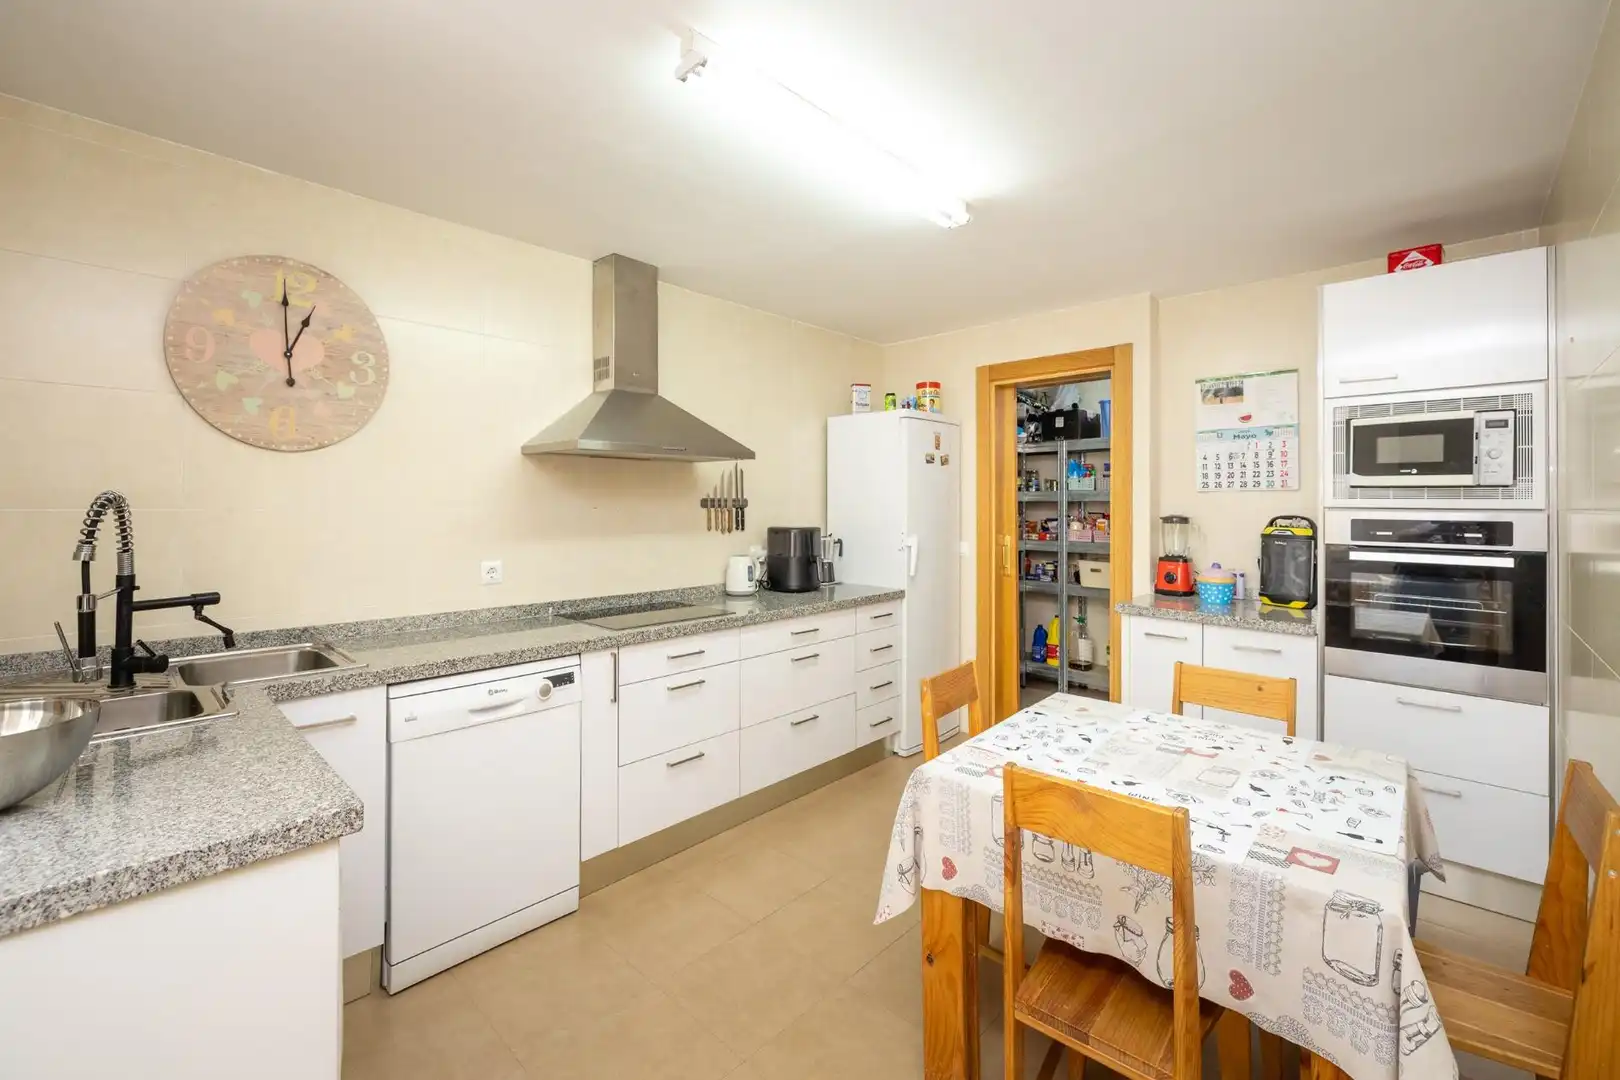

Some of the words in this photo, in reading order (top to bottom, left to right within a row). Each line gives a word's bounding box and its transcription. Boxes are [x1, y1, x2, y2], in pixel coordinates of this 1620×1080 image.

[272, 267, 318, 308] 12
[184, 326, 216, 363] 9
[349, 350, 377, 386] 3
[1280, 469, 1288, 478] 24
[1280, 479, 1288, 488] 31
